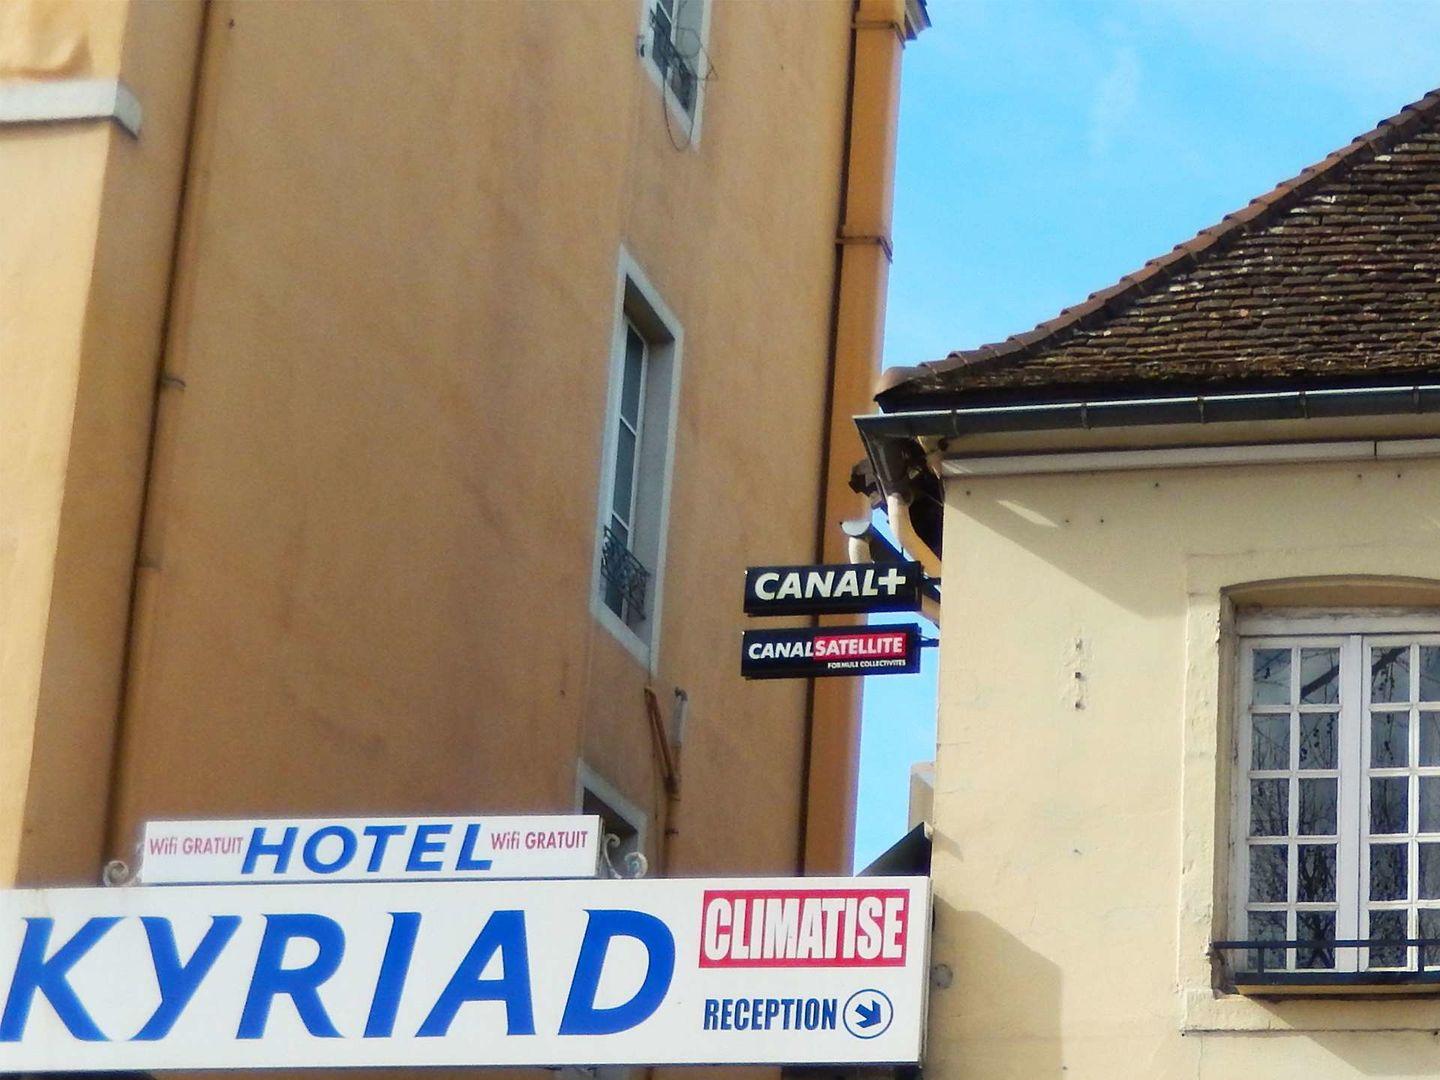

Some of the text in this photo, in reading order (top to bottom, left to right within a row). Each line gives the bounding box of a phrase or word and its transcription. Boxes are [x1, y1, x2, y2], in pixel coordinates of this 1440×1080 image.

[755, 568, 907, 601] CANAL+
[150, 836, 244, 855] Wifi GRATUIT
[240, 823, 493, 874] HOTEL
[490, 831, 588, 850] Wifi GRATUIT
[704, 896, 905, 961] CLIMATISE
[0, 909, 676, 1043] KYRIAD
[703, 998, 838, 1031] RECEPTION
